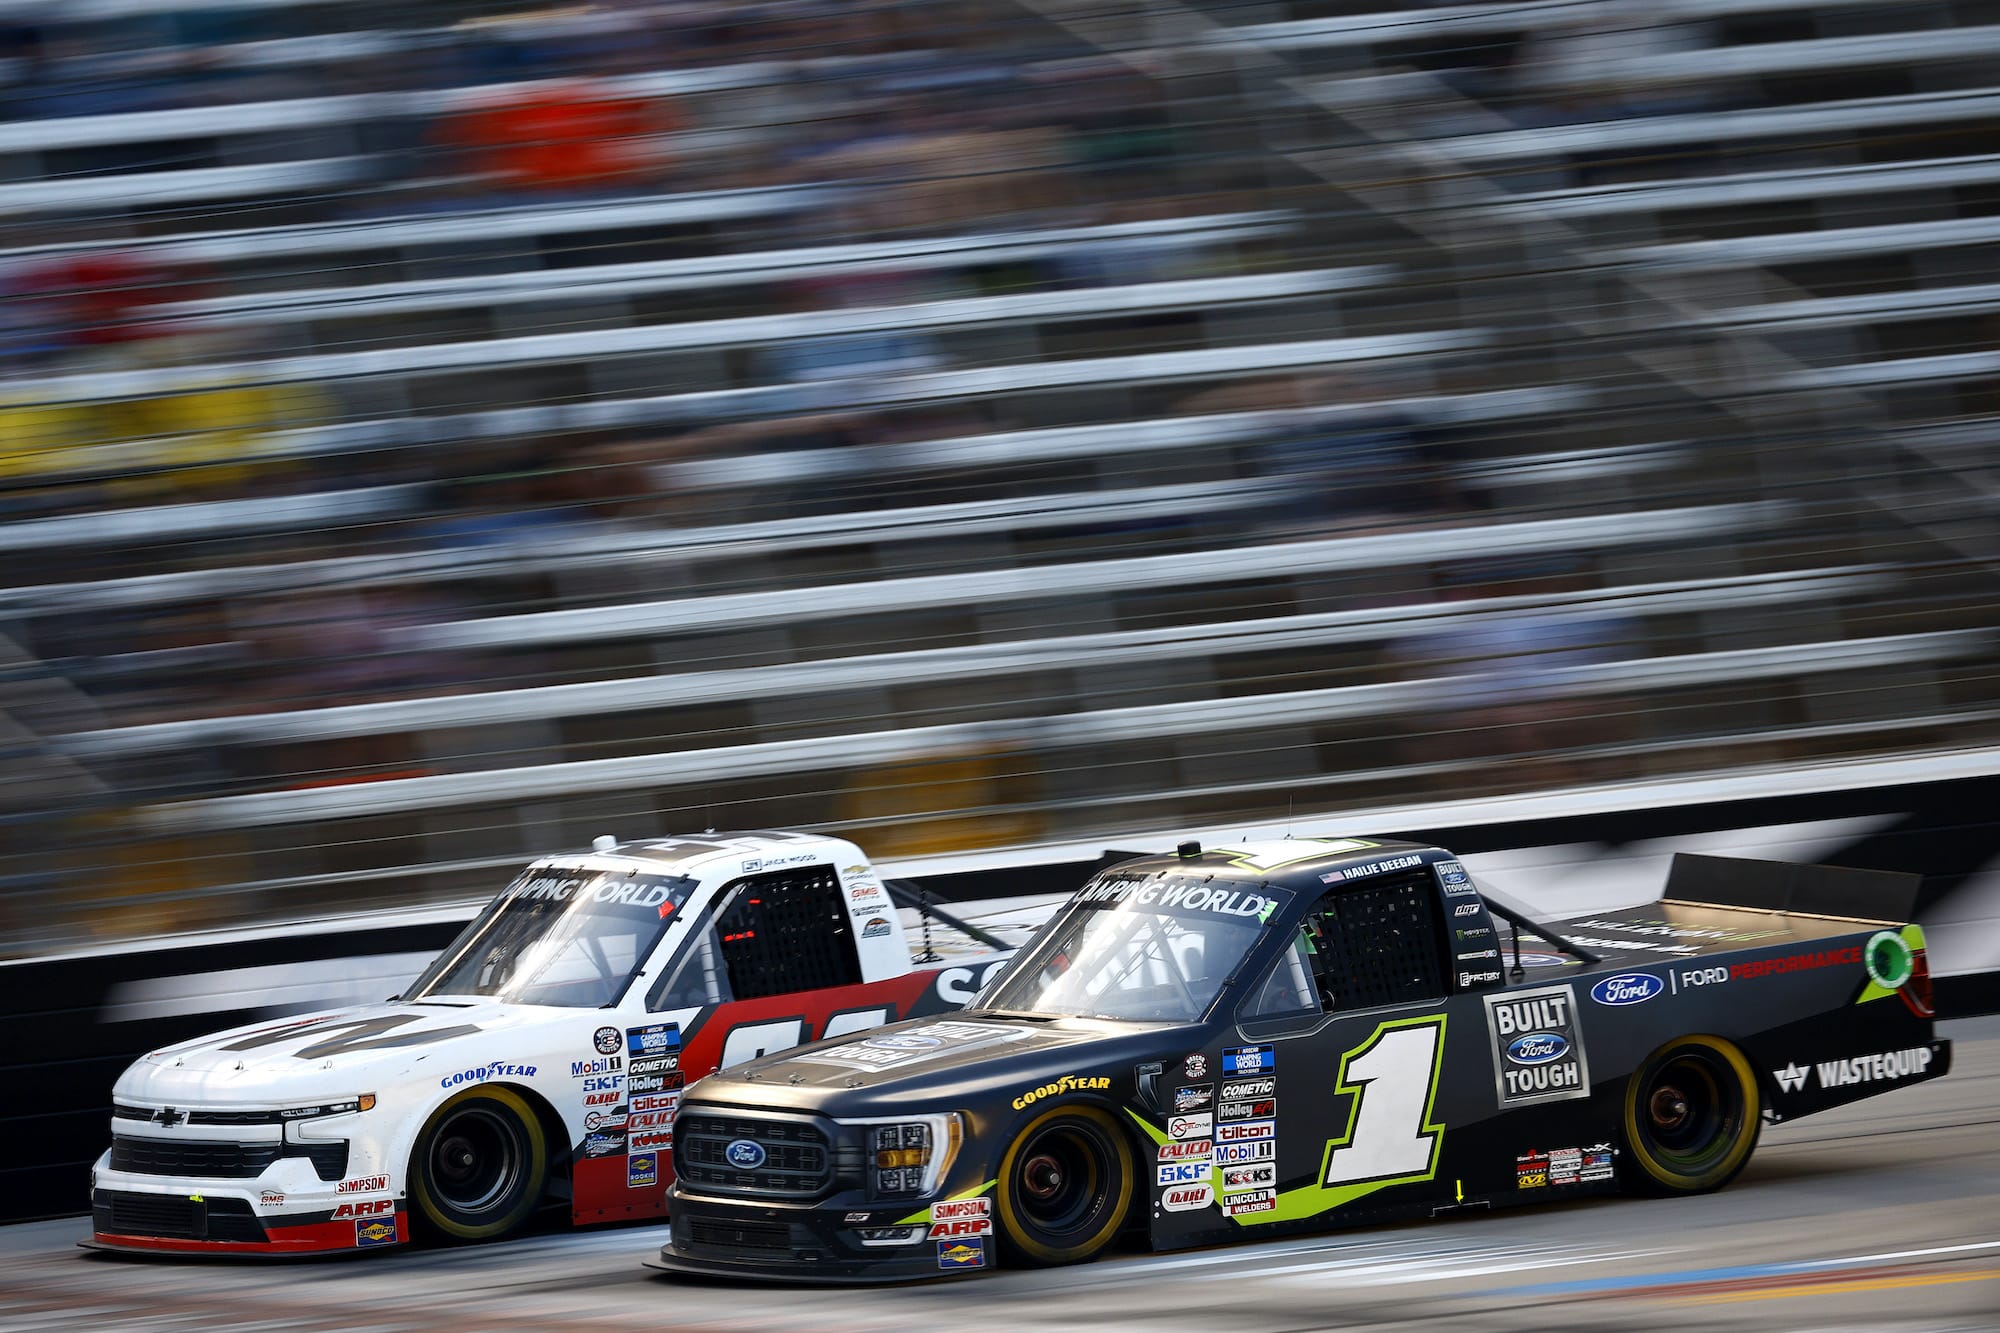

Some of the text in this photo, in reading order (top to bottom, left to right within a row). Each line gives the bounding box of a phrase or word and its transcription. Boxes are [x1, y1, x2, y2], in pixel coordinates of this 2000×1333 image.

[1343, 855, 1422, 879] HAILIE DEEGAN
[1438, 863, 1463, 875] BUILT
[575, 878, 670, 907] WORLD
[851, 887, 878, 898] GMS
[1446, 882, 1472, 893] TOUGH
[1073, 879, 1266, 918] CAMPING WORLD
[1681, 967, 1729, 988] FORD
[1730, 946, 1862, 981] PERFORMANCE
[1605, 977, 1651, 1002] Ford
[1496, 999, 1566, 1035] BUILT
[642, 1039, 667, 1049] WORLD
[1519, 1037, 1555, 1058] Ford
[571, 1058, 607, 1075] Mobil
[610, 1057, 620, 1069] 1
[630, 1057, 678, 1073] COMETIC
[1235, 1053, 1262, 1062] CAMPING
[1236, 1060, 1262, 1070] WORLD
[441, 1061, 538, 1088] GOODYEAR
[1816, 1047, 1933, 1088] WASTEQUIP
[583, 1075, 625, 1091] SKF
[629, 1077, 663, 1091] Holley
[1505, 1062, 1579, 1094] TOUGH
[1012, 1075, 1111, 1110] GOODYEAR
[1222, 1081, 1273, 1097] COMETIC
[1221, 1101, 1273, 1117] Holley EFI
[1324, 1016, 1445, 1188] 1
[1220, 1126, 1271, 1140] tilton
[734, 1144, 757, 1162] Ford
[1160, 1141, 1211, 1158] CALICO
[1216, 1144, 1255, 1160] Mobil
[1260, 1142, 1271, 1156] 1
[630, 1172, 654, 1180] ROOKIE
[1160, 1163, 1210, 1182] SKF
[1224, 1167, 1272, 1186] KOOKS
[338, 1177, 386, 1192] SIMPSON
[261, 1195, 285, 1203] GMS
[1225, 1192, 1267, 1206] LINCOLN
[335, 1200, 392, 1217] ARP
[935, 1201, 985, 1219] SIMPSON
[1234, 1202, 1271, 1214] WELDERS
[360, 1227, 394, 1238] SUNOCO
[929, 1219, 990, 1237] ARP
[942, 1247, 983, 1260] SUNOCO
